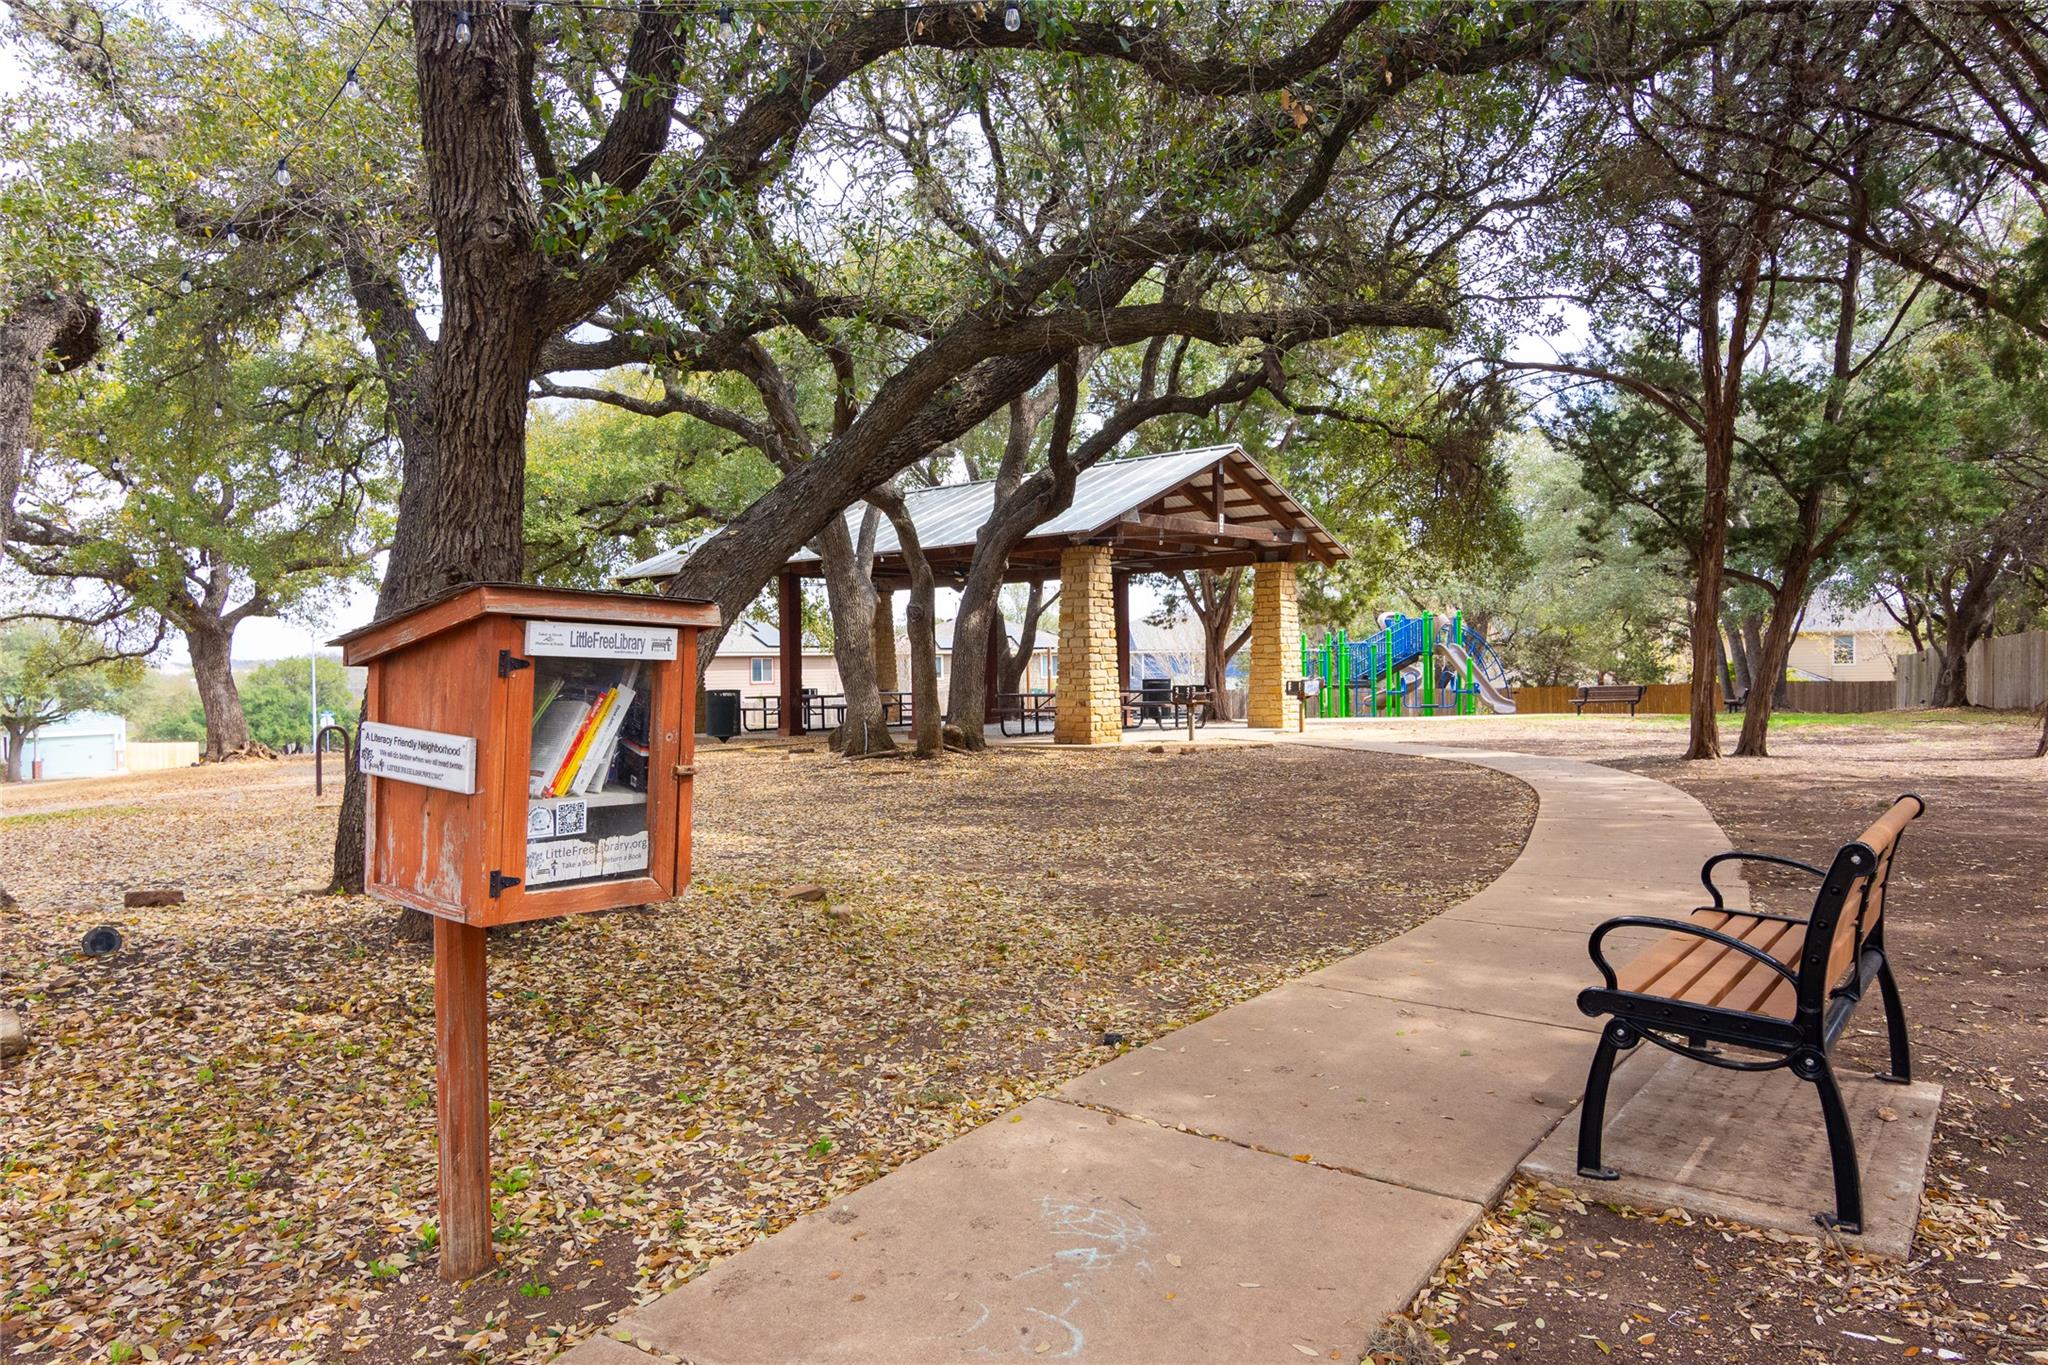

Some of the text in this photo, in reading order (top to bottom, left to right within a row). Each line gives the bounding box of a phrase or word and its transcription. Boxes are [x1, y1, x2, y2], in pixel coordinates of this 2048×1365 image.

[570, 630, 646, 654] LittleFreeLibrary
[365, 732, 461, 757] A Literacy Friendly Neighborhood
